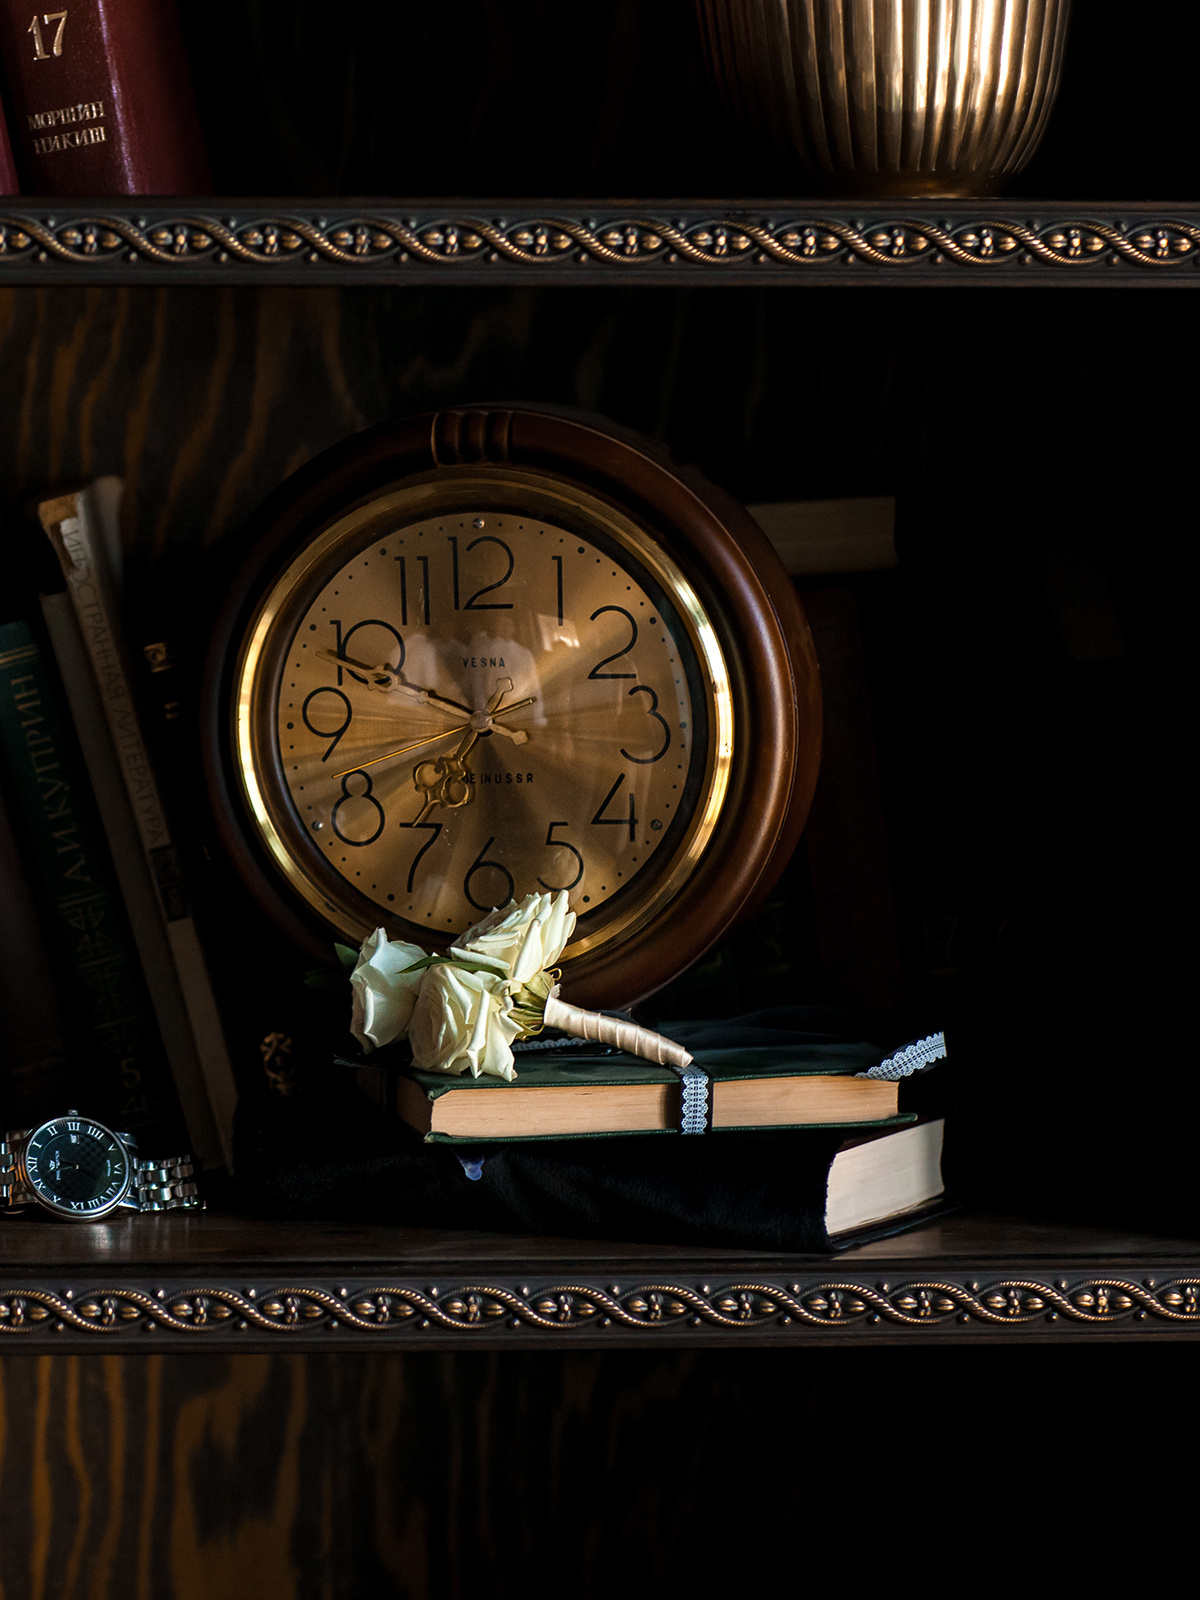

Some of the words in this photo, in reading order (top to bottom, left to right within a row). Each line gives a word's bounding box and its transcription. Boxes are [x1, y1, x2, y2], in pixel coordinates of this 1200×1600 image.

[26, 9, 68, 61] 17
[26, 101, 106, 132] МОРШИН
[33, 127, 106, 155] НИКИШ
[394, 555, 434, 625] 11
[448, 535, 515, 610] 12
[551, 555, 563, 626] 1
[329, 619, 405, 686] 10
[462, 657, 506, 668] VESNA
[588, 604, 638, 680] 2
[10, 673, 72, 821] КУПРИН
[302, 686, 352, 762] 9
[620, 685, 670, 764] 3
[113, 708, 166, 845] ЛИТЕРАТУРА
[481, 774, 491, 784] IN
[494, 773, 534, 784] USSR
[331, 769, 386, 847] 8
[591, 772, 639, 842] 4
[399, 822, 443, 893] 7
[464, 836, 515, 912] 6
[536, 821, 584, 892] 5
[120, 1056, 142, 1088] 5
[46, 1125, 59, 1137] II
[67, 1121, 80, 1132] III
[87, 1125, 106, 1140] IIII
[107, 1143, 118, 1152] V
[27, 1156, 38, 1173] XII
[33, 1178, 47, 1191] XI
[113, 1162, 124, 1175] VI
[52, 1195, 61, 1204] X
